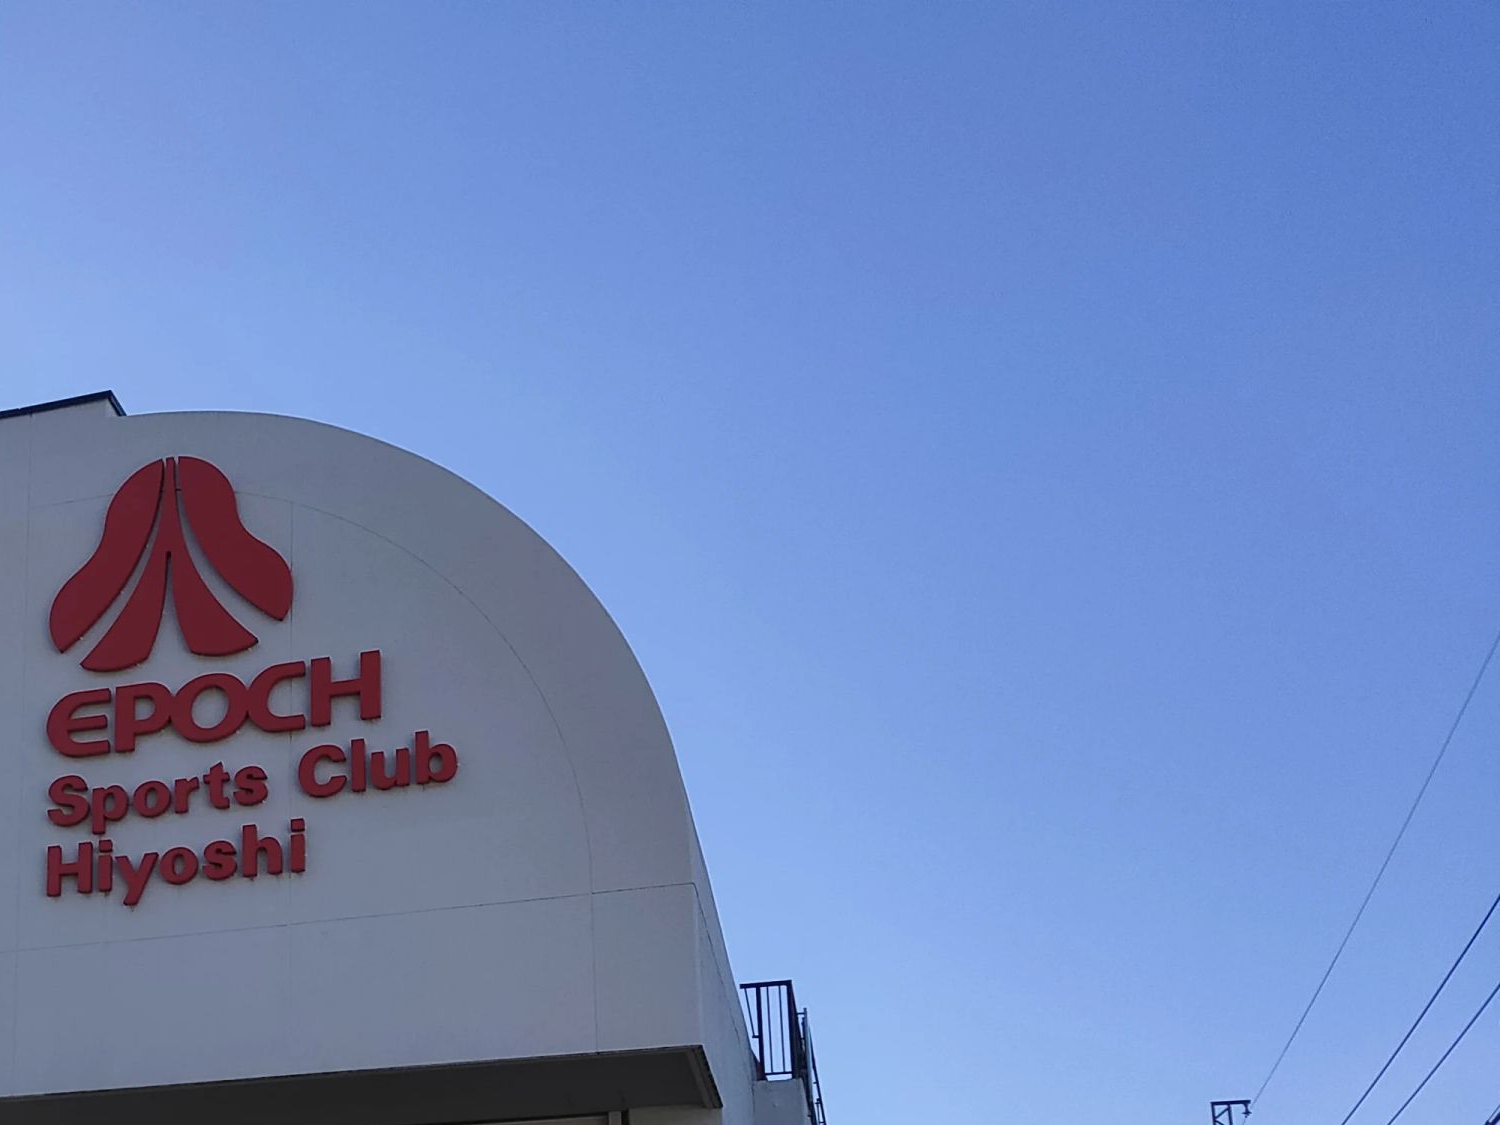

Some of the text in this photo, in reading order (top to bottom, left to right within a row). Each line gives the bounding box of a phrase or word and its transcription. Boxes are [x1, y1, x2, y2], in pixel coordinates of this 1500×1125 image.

[46, 649, 382, 758] EPOCH
[46, 731, 458, 835] Sports Club
[46, 818, 306, 907] Hiyoshi
